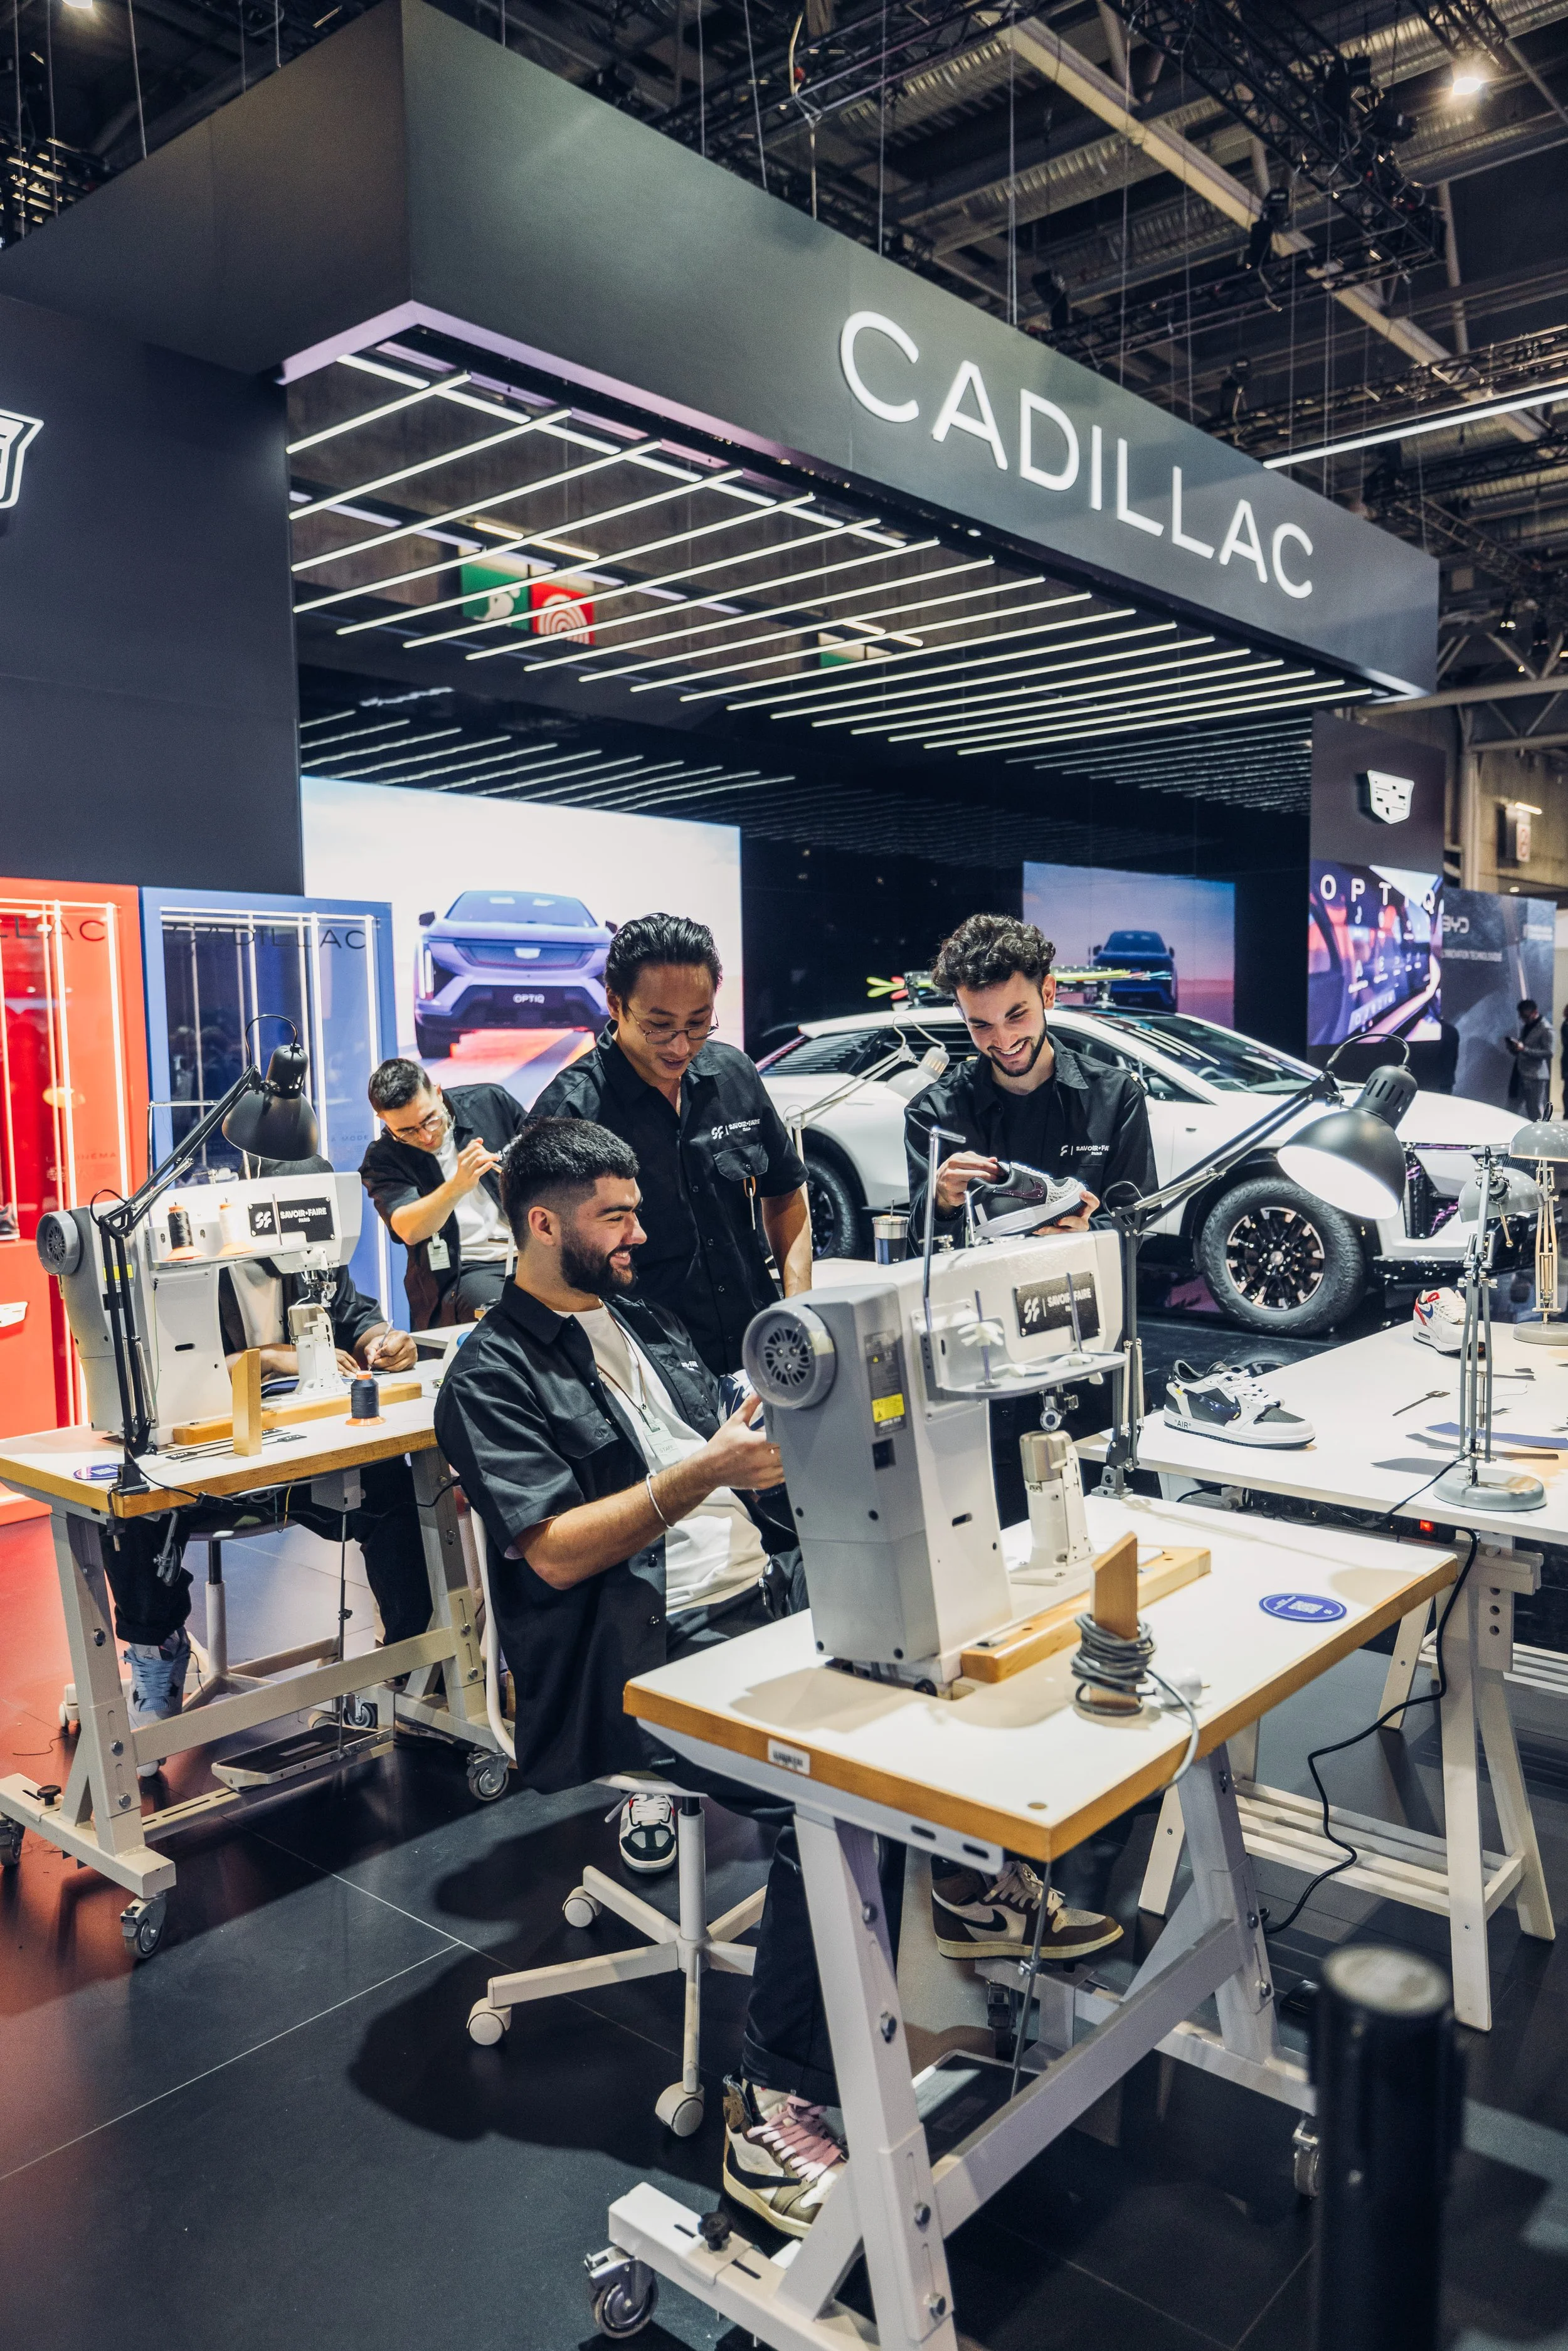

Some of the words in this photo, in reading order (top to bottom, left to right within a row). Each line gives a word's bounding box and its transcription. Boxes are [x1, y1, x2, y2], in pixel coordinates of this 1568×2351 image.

[840, 310, 1313, 599] CADILLAC
[1442, 915, 1470, 933] BYD
[513, 994, 545, 1004] OPTIQ
